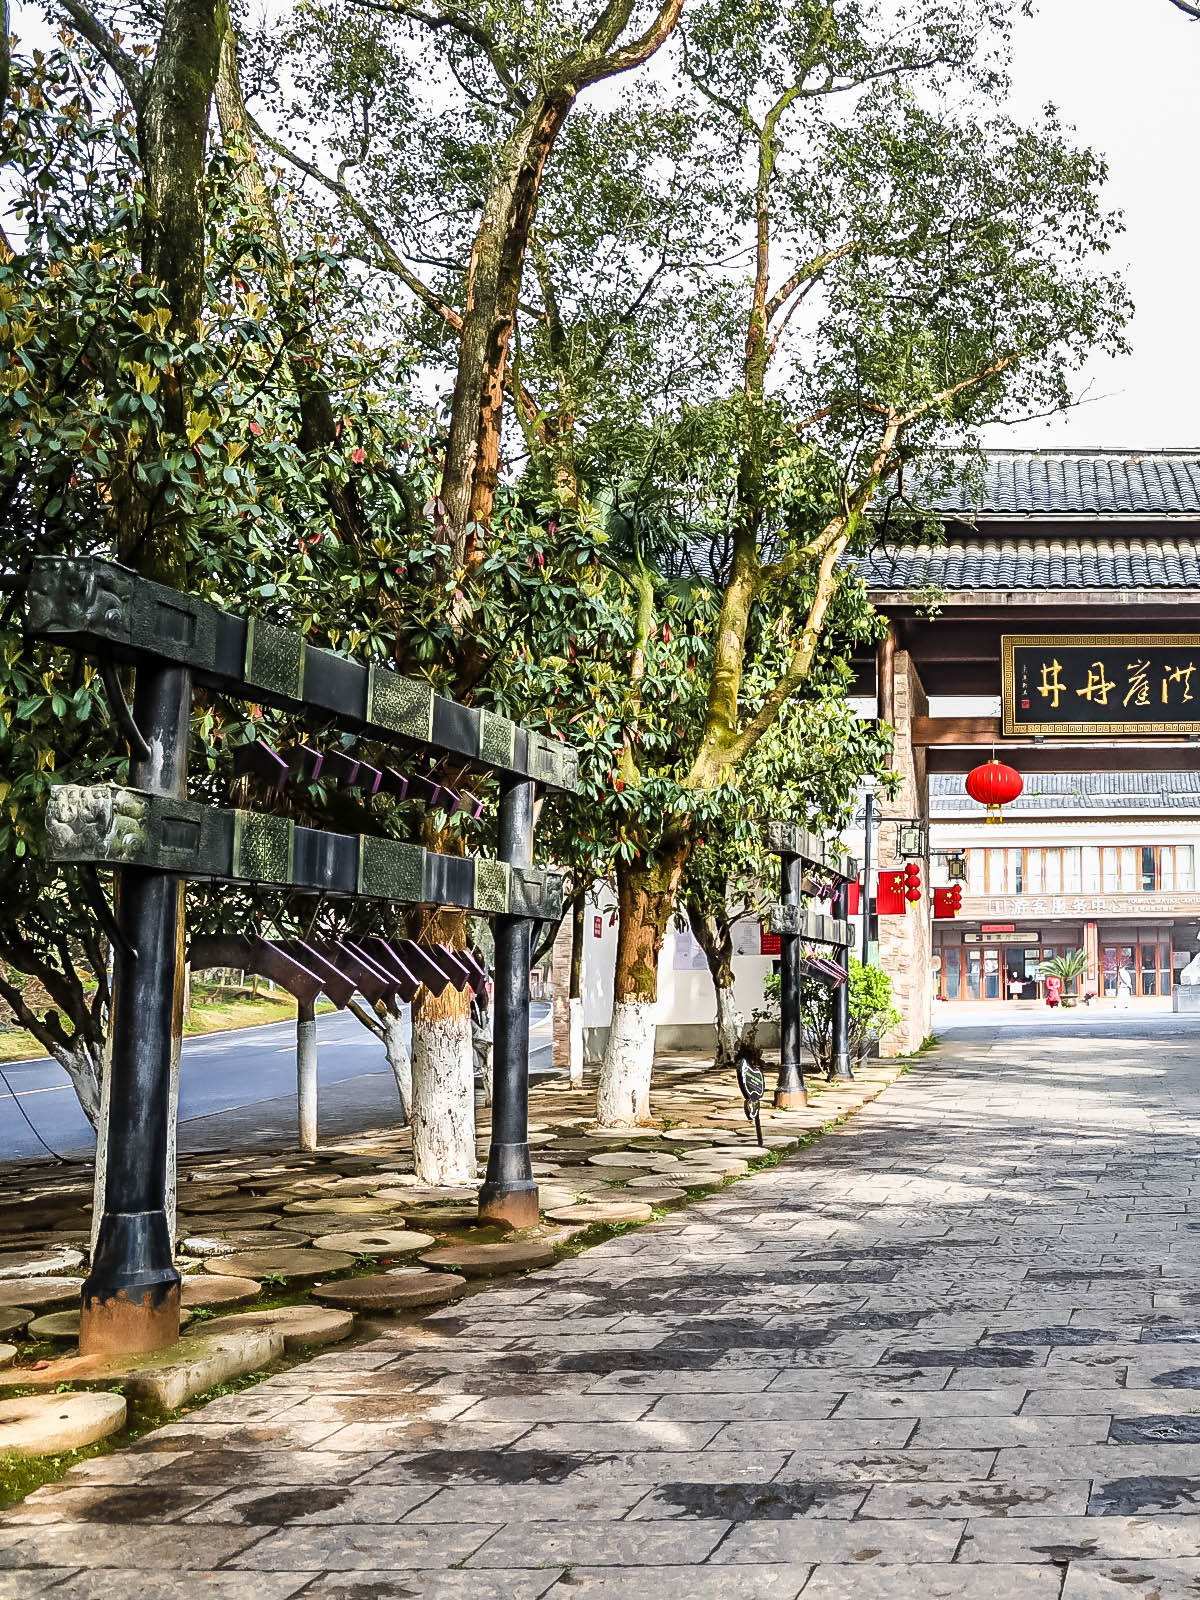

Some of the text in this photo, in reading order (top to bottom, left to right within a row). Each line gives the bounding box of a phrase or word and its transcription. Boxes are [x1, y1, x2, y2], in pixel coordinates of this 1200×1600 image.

[1010, 898, 1123, 915] 游客服务中心
